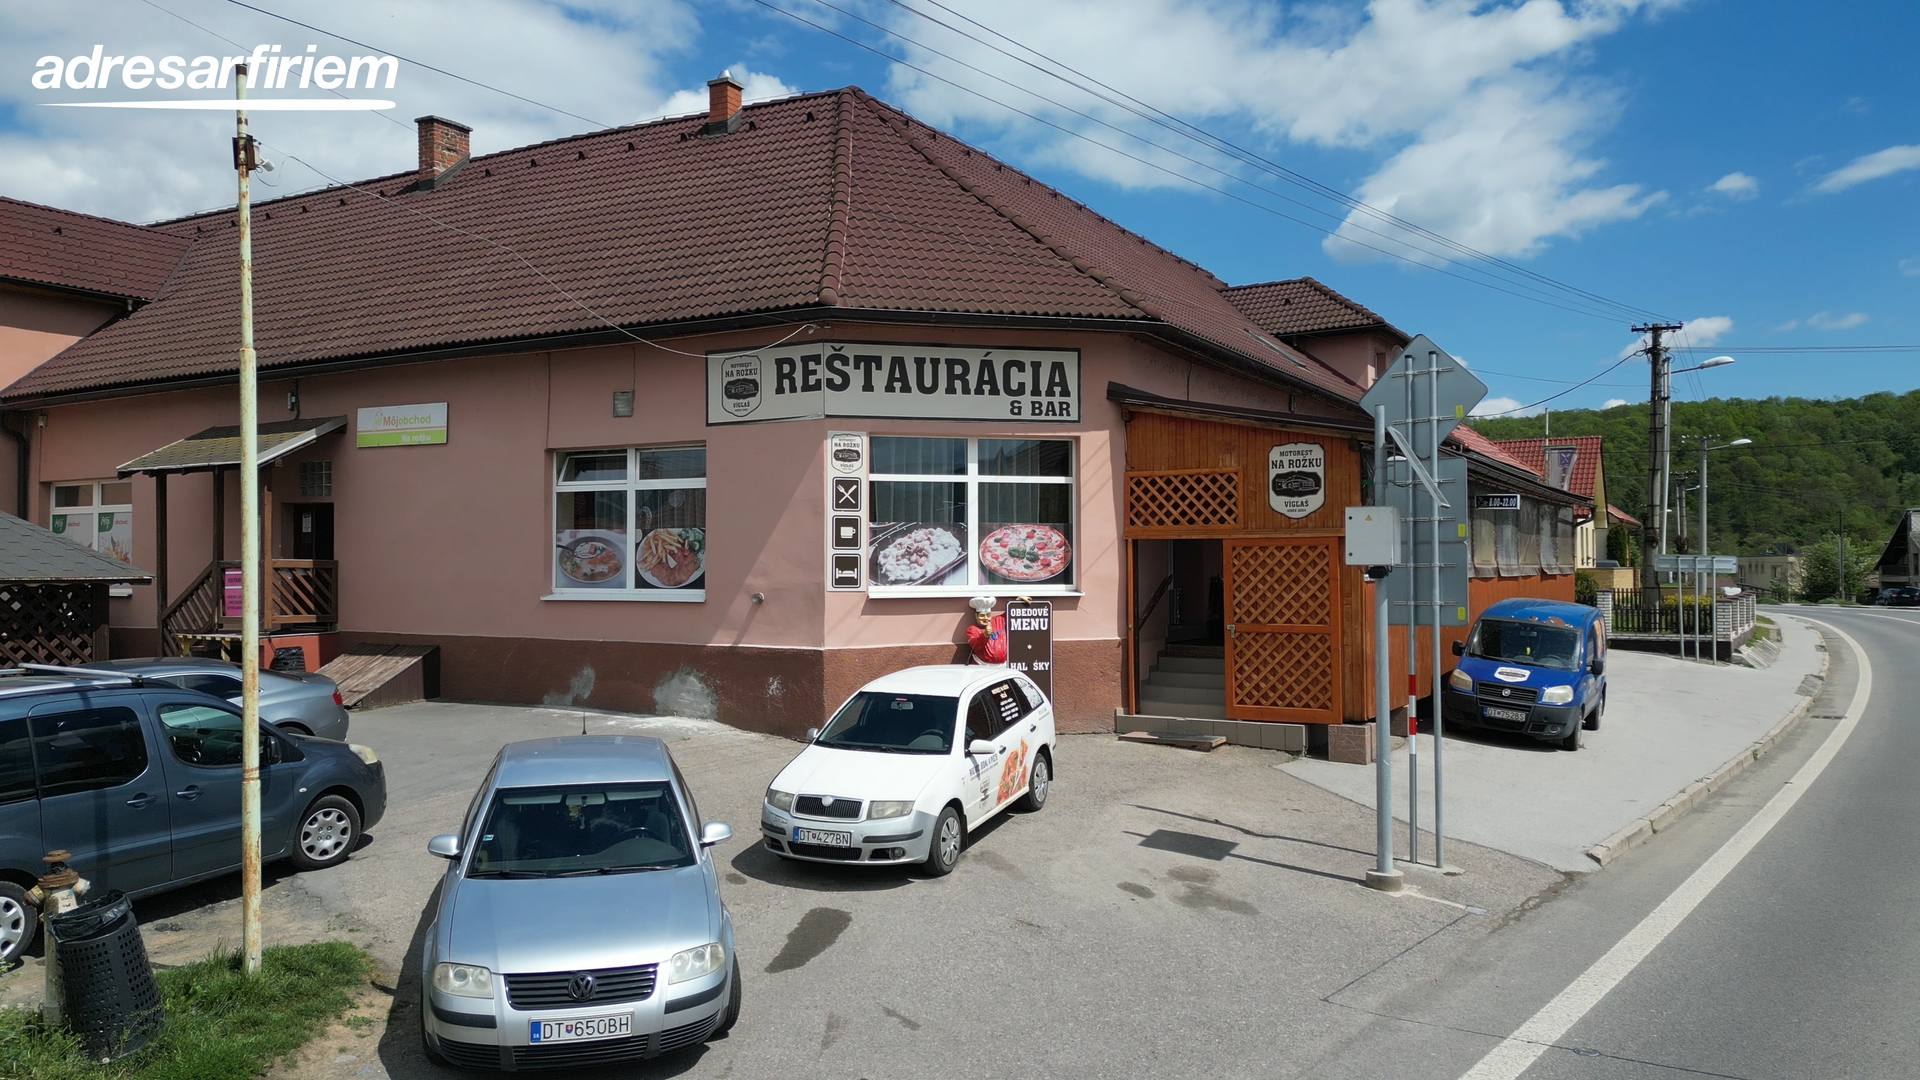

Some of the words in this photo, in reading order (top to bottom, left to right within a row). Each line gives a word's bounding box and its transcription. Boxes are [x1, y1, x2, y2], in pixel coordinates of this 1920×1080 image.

[725, 370, 734, 378] NA
[774, 346, 1072, 398] REŠTAURÁCIA
[1009, 400, 1023, 416] &
[1030, 401, 1071, 417] BAR
[401, 434, 410, 443] Na
[1271, 460, 1285, 469] NA
[1288, 456, 1322, 469] ROŽKU
[1010, 606, 1049, 617] OBEDOVÉ
[1010, 618, 1049, 631] MENU
[799, 830, 811, 841] DT
[816, 832, 849, 844] 427BN
[543, 1022, 564, 1039] DT
[574, 1017, 629, 1036] 650BH
